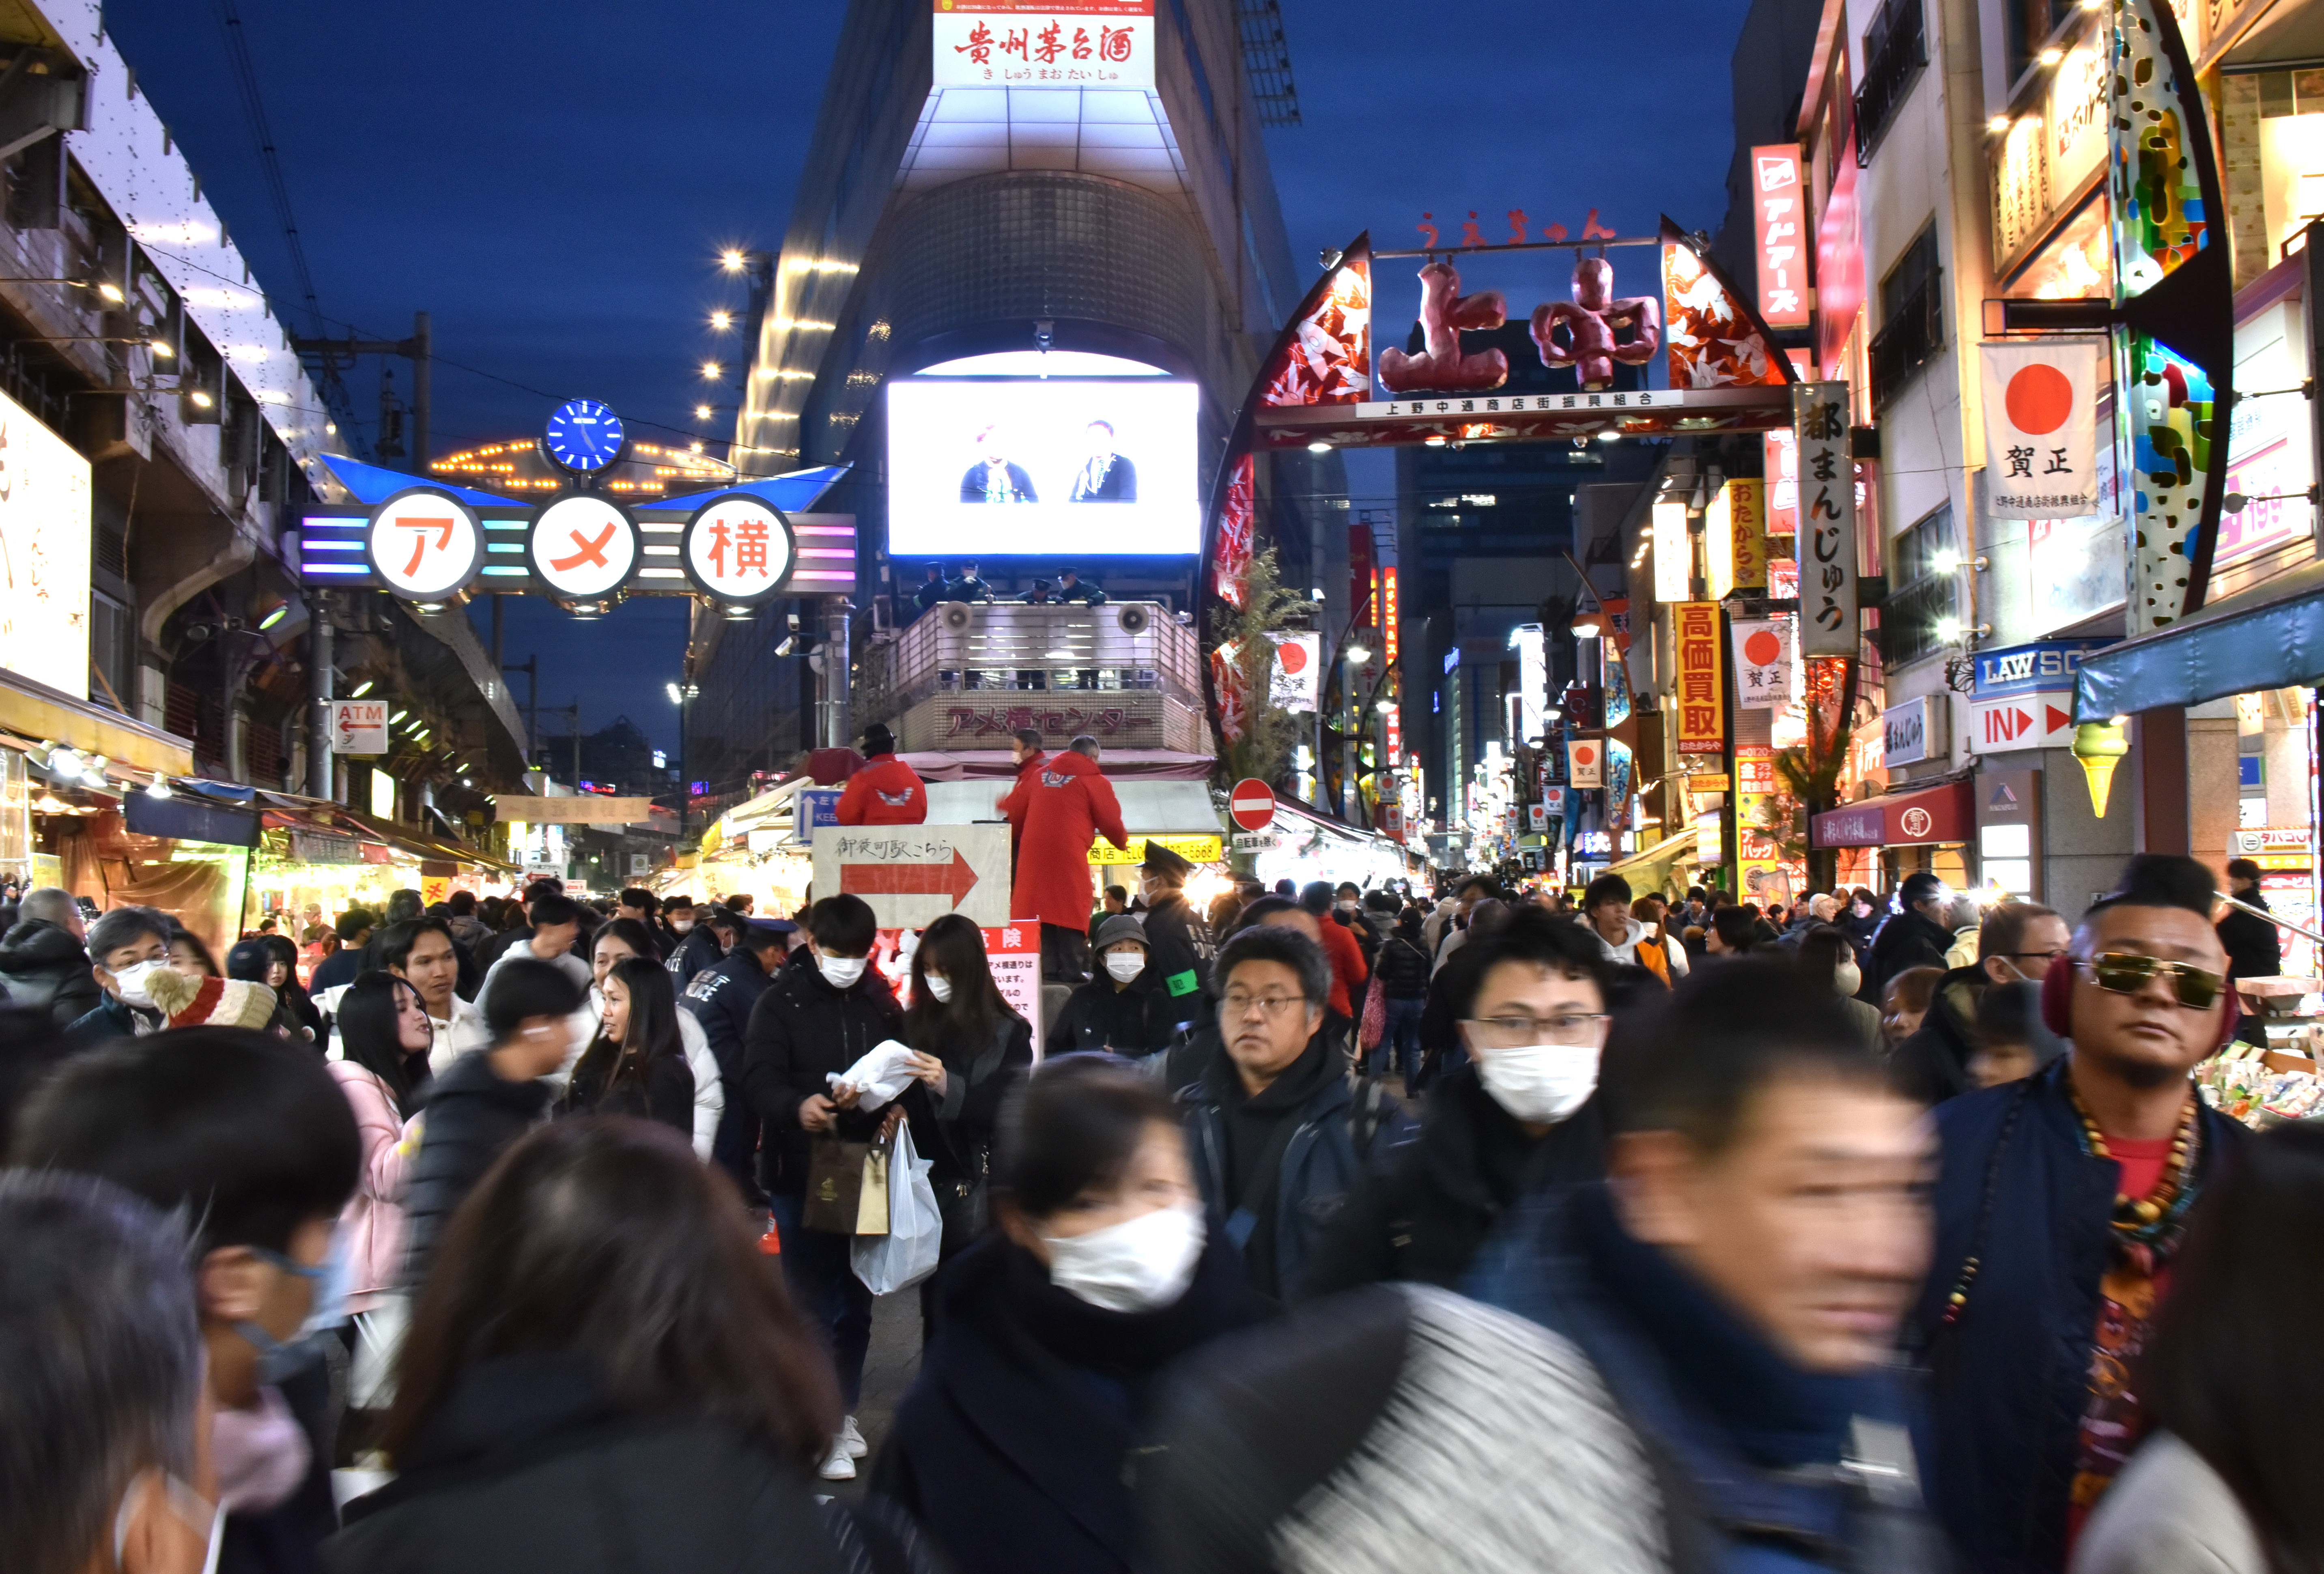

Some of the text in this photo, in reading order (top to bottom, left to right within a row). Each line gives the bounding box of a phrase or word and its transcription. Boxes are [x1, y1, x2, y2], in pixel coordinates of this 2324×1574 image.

[983, 69, 993, 80] き
[1039, 69, 1061, 80] まお
[1068, 69, 1092, 80] たい
[1764, 199, 1799, 313] アドアーズ
[1379, 258, 1660, 392] 上中
[1386, 392, 1653, 415] 上野中通商店街振興組合
[2004, 445, 2073, 477] 賀正
[1803, 402, 1843, 632] 都まんじゅう
[395, 517, 769, 578] アメ横
[1681, 606, 1716, 736] 高価買取
[1747, 671, 1783, 688] 賀正
[339, 706, 382, 720] ATM
[947, 707, 1152, 736] アメ横センター
[1985, 707, 2013, 743] IN
[1679, 741, 1721, 750] おたからや
[1740, 763, 1756, 779] 金
[835, 836, 951, 861] 御徒町駅こちら
[1090, 847, 1115, 860] 商店
[1742, 843, 1773, 858] バッグ
